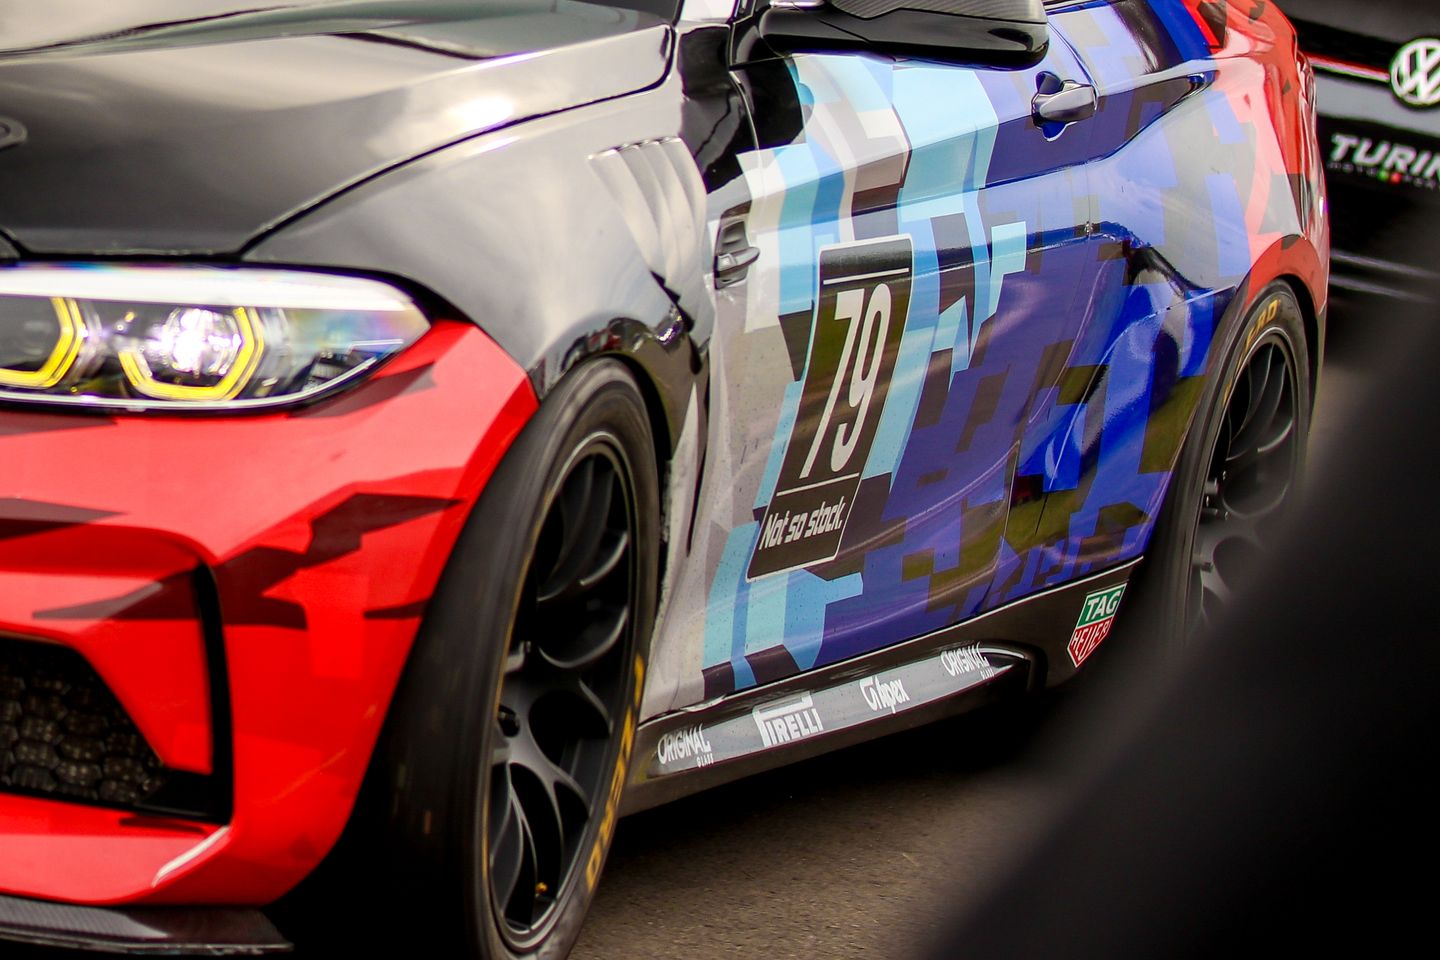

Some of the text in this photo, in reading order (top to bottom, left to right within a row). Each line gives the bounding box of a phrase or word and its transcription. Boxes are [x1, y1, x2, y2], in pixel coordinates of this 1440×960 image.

[799, 283, 892, 479] 79
[759, 496, 847, 550] Not so stock.
[1085, 590, 1122, 622] TAG
[940, 642, 991, 677] ORIGINAL
[1070, 620, 1111, 662] HEUER
[752, 691, 824, 748] PIRELLI
[657, 722, 712, 765] ORIGINAL
